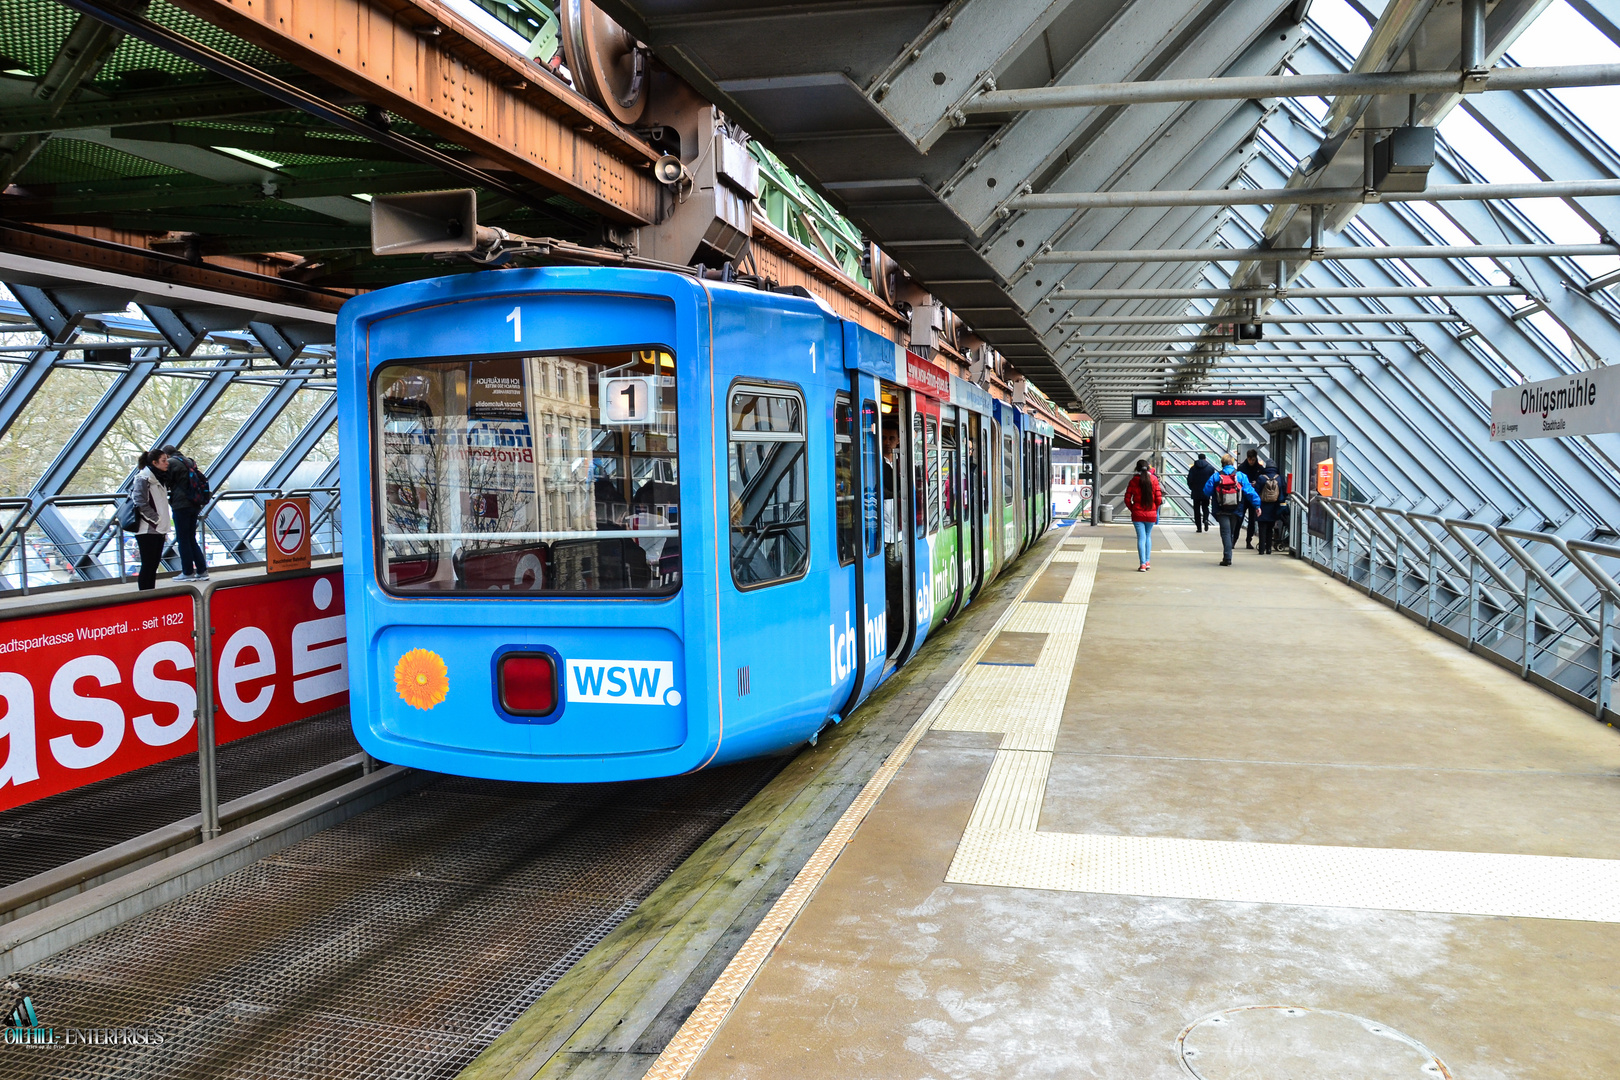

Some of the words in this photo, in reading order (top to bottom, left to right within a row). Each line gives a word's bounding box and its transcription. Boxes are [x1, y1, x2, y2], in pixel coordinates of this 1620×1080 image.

[506, 306, 522, 343] 1
[808, 341, 816, 374] 1
[620, 383, 636, 418] 1
[1520, 377, 1597, 419] Ohligsmühle
[1542, 418, 1566, 432] Stadthalle
[76, 621, 128, 641] Wuppertal
[142, 617, 158, 630] seit
[161, 612, 184, 626] 1822
[829, 610, 857, 687] Ich
[935, 557, 949, 604] mit
